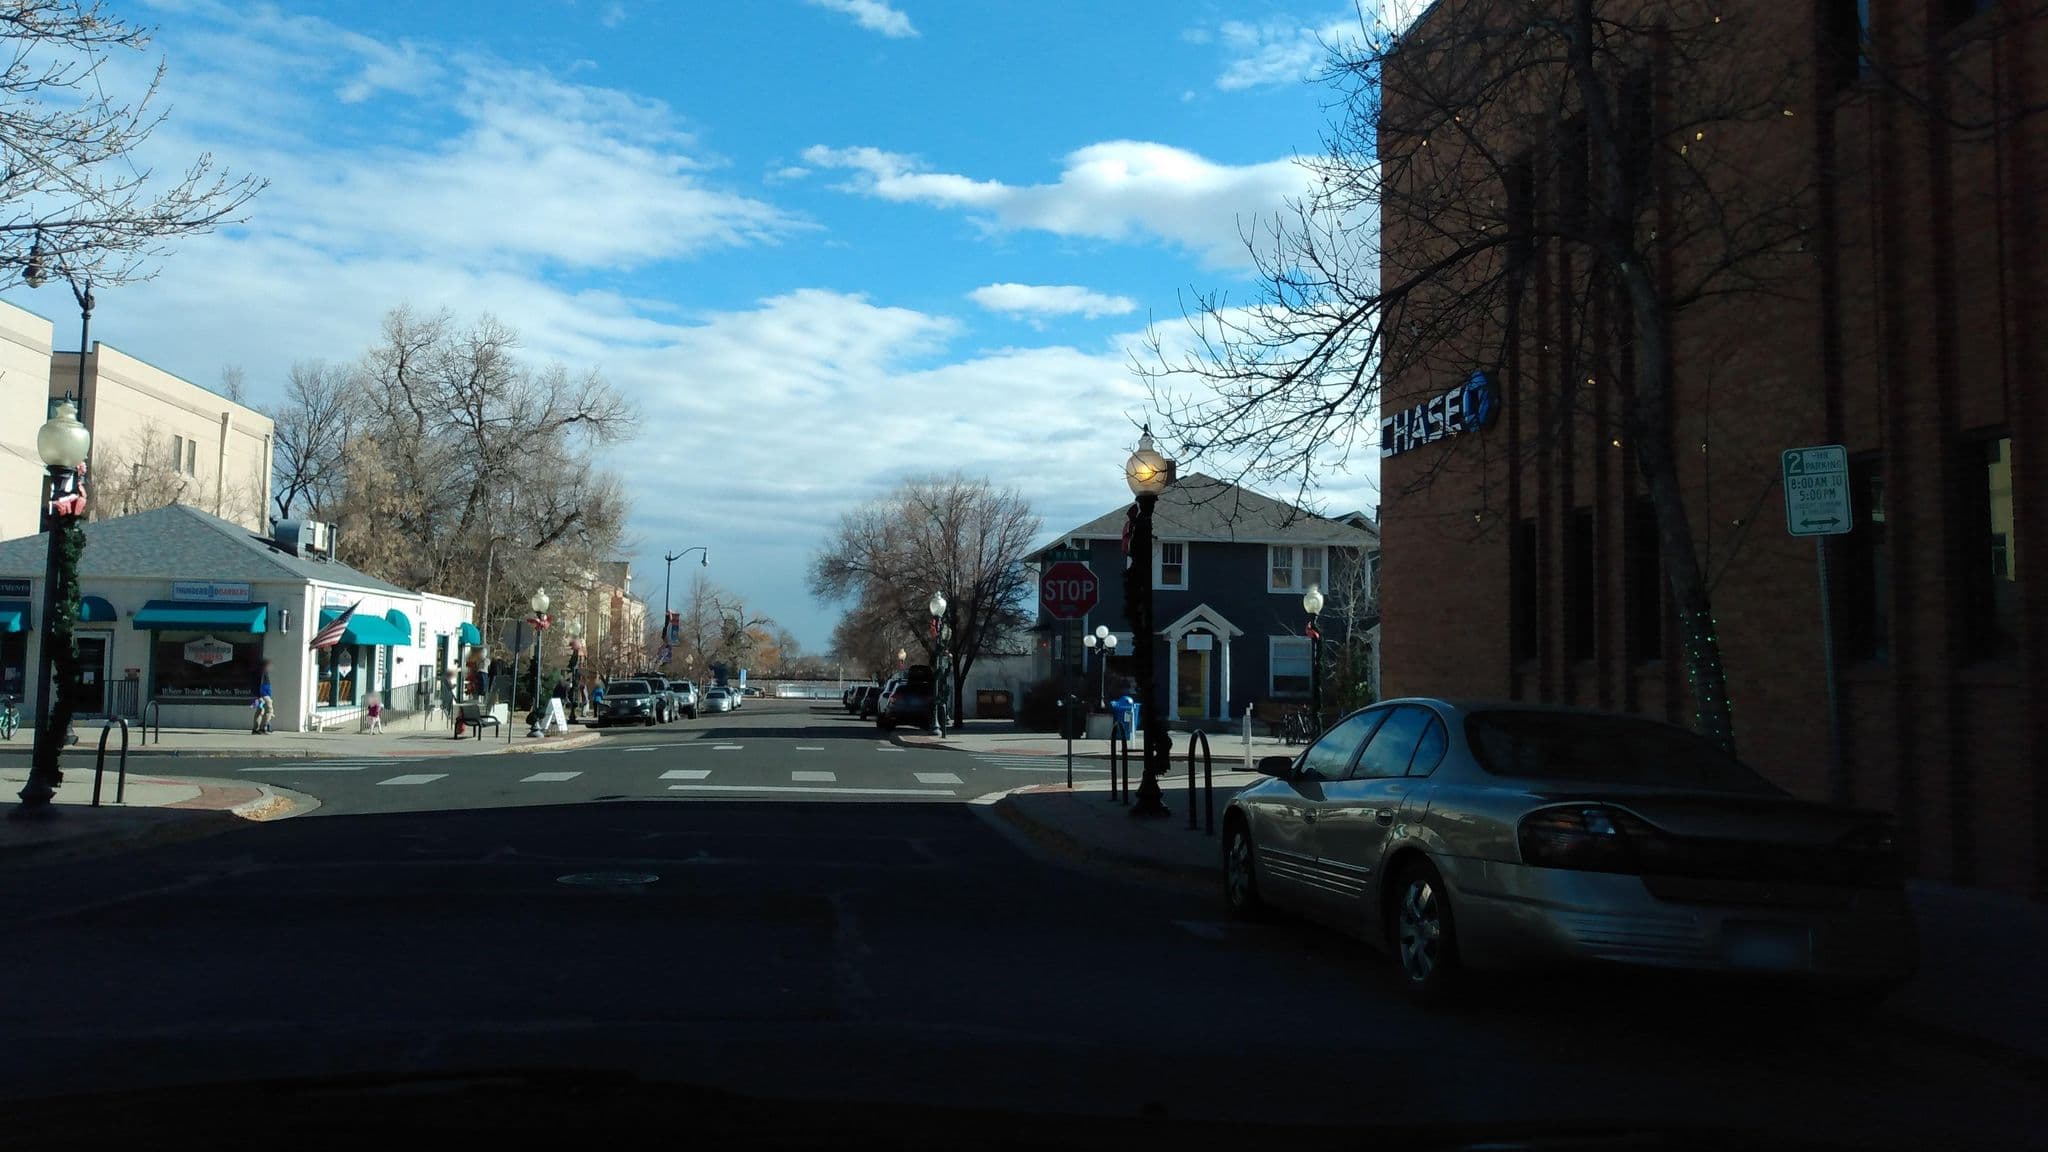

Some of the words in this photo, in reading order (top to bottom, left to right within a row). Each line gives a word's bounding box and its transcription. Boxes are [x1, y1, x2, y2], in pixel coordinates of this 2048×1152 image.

[1381, 388, 1463, 459] CHASE
[1788, 452, 1802, 473] 2
[1805, 460, 1841, 471] PARKING
[1045, 579, 1095, 601] STOP
